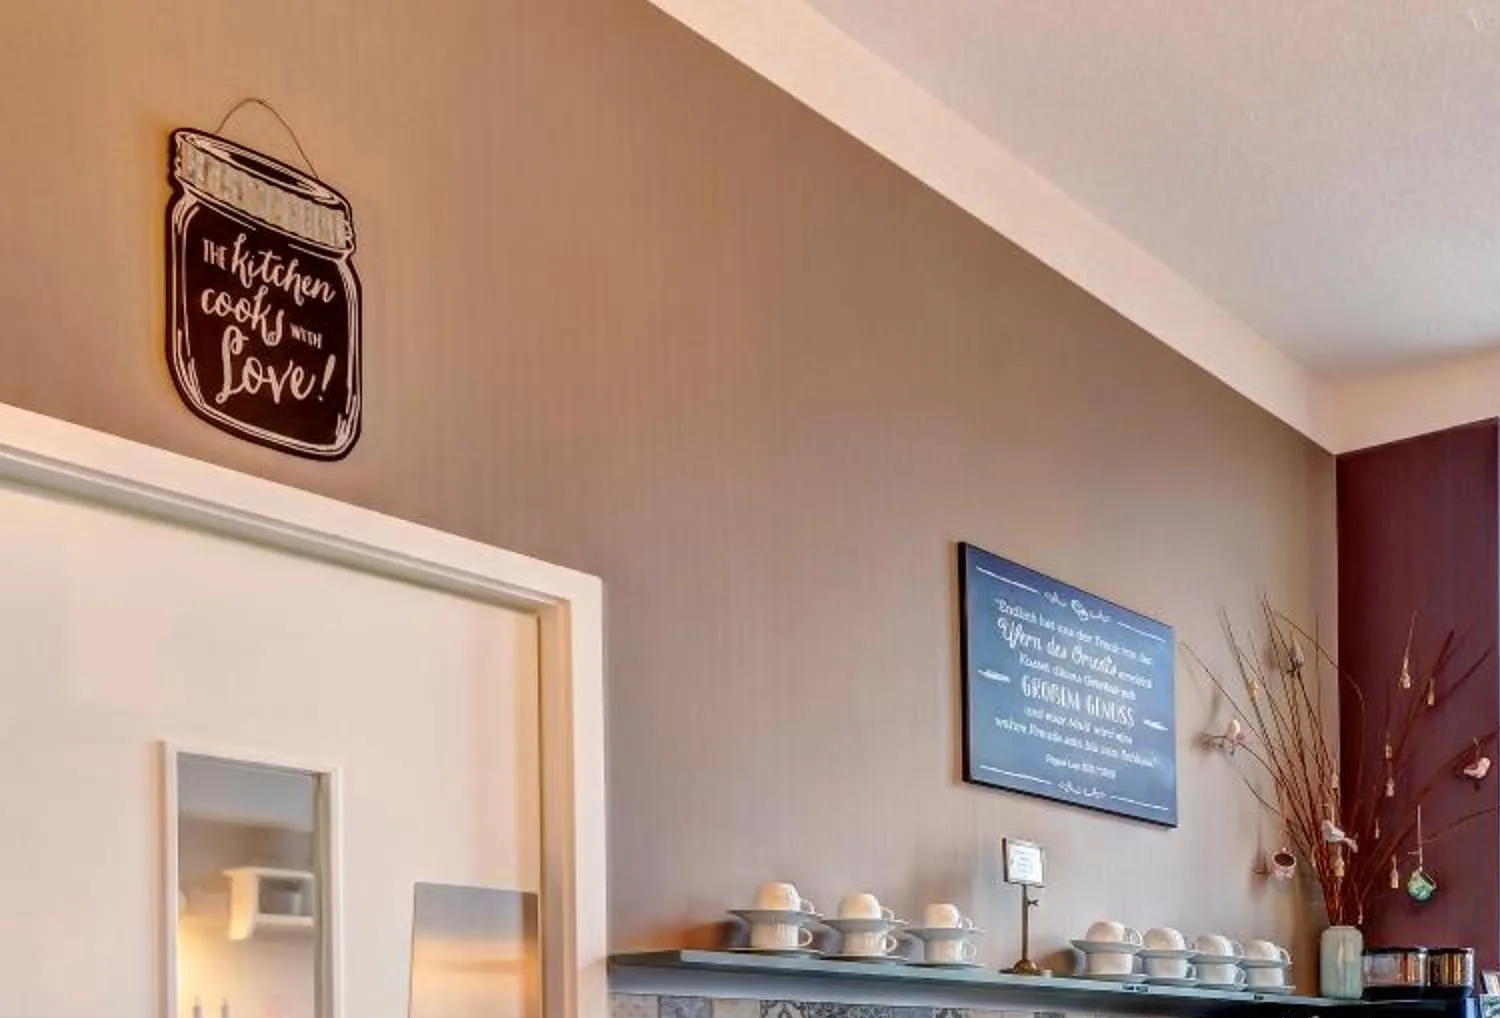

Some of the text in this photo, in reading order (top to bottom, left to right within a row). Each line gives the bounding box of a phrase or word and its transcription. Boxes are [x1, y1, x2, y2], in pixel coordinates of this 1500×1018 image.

[203, 233, 336, 306] THE kitchen
[200, 285, 322, 349] cooks WITH
[215, 325, 337, 406] Love!
